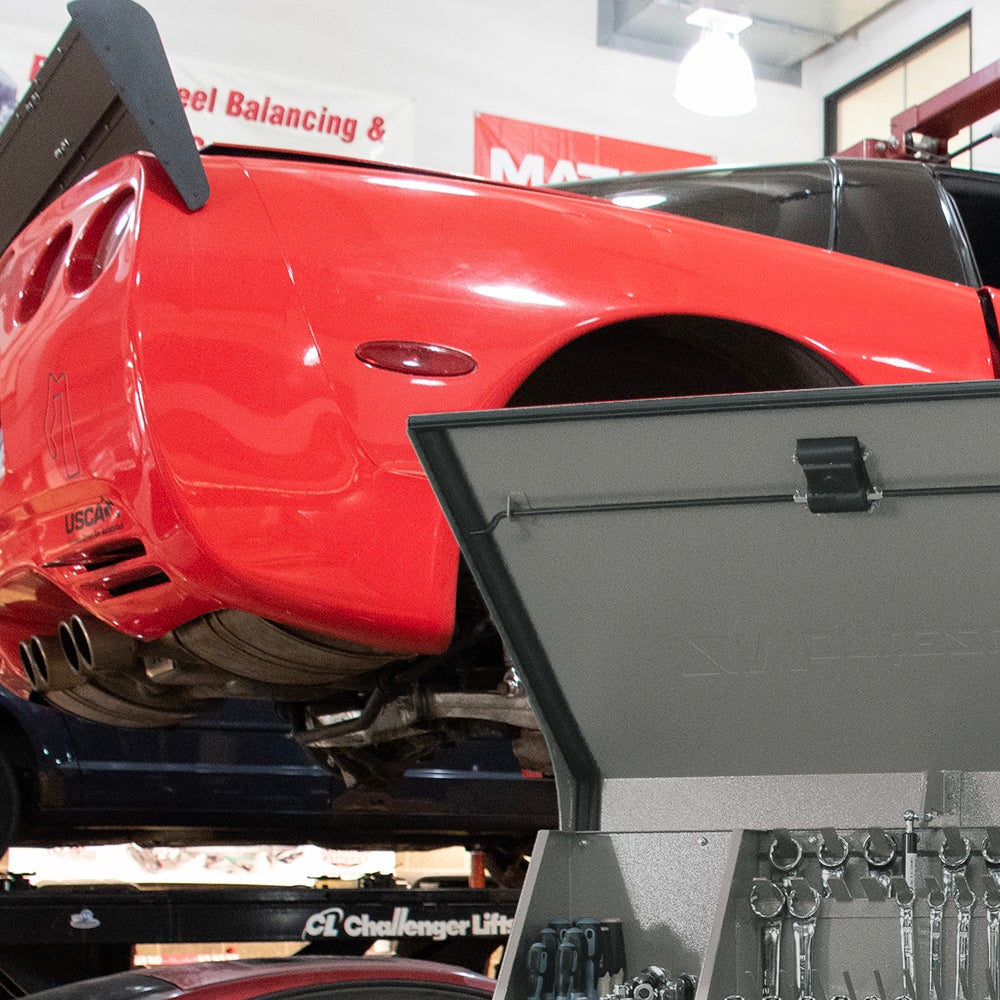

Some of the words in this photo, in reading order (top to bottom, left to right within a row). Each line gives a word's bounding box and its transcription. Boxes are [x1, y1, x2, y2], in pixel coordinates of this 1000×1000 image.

[177, 87, 218, 114] eel
[225, 90, 358, 144] Balancing
[367, 115, 386, 143] &
[343, 906, 471, 941] Challenger
[471, 912, 515, 936] Lifts
